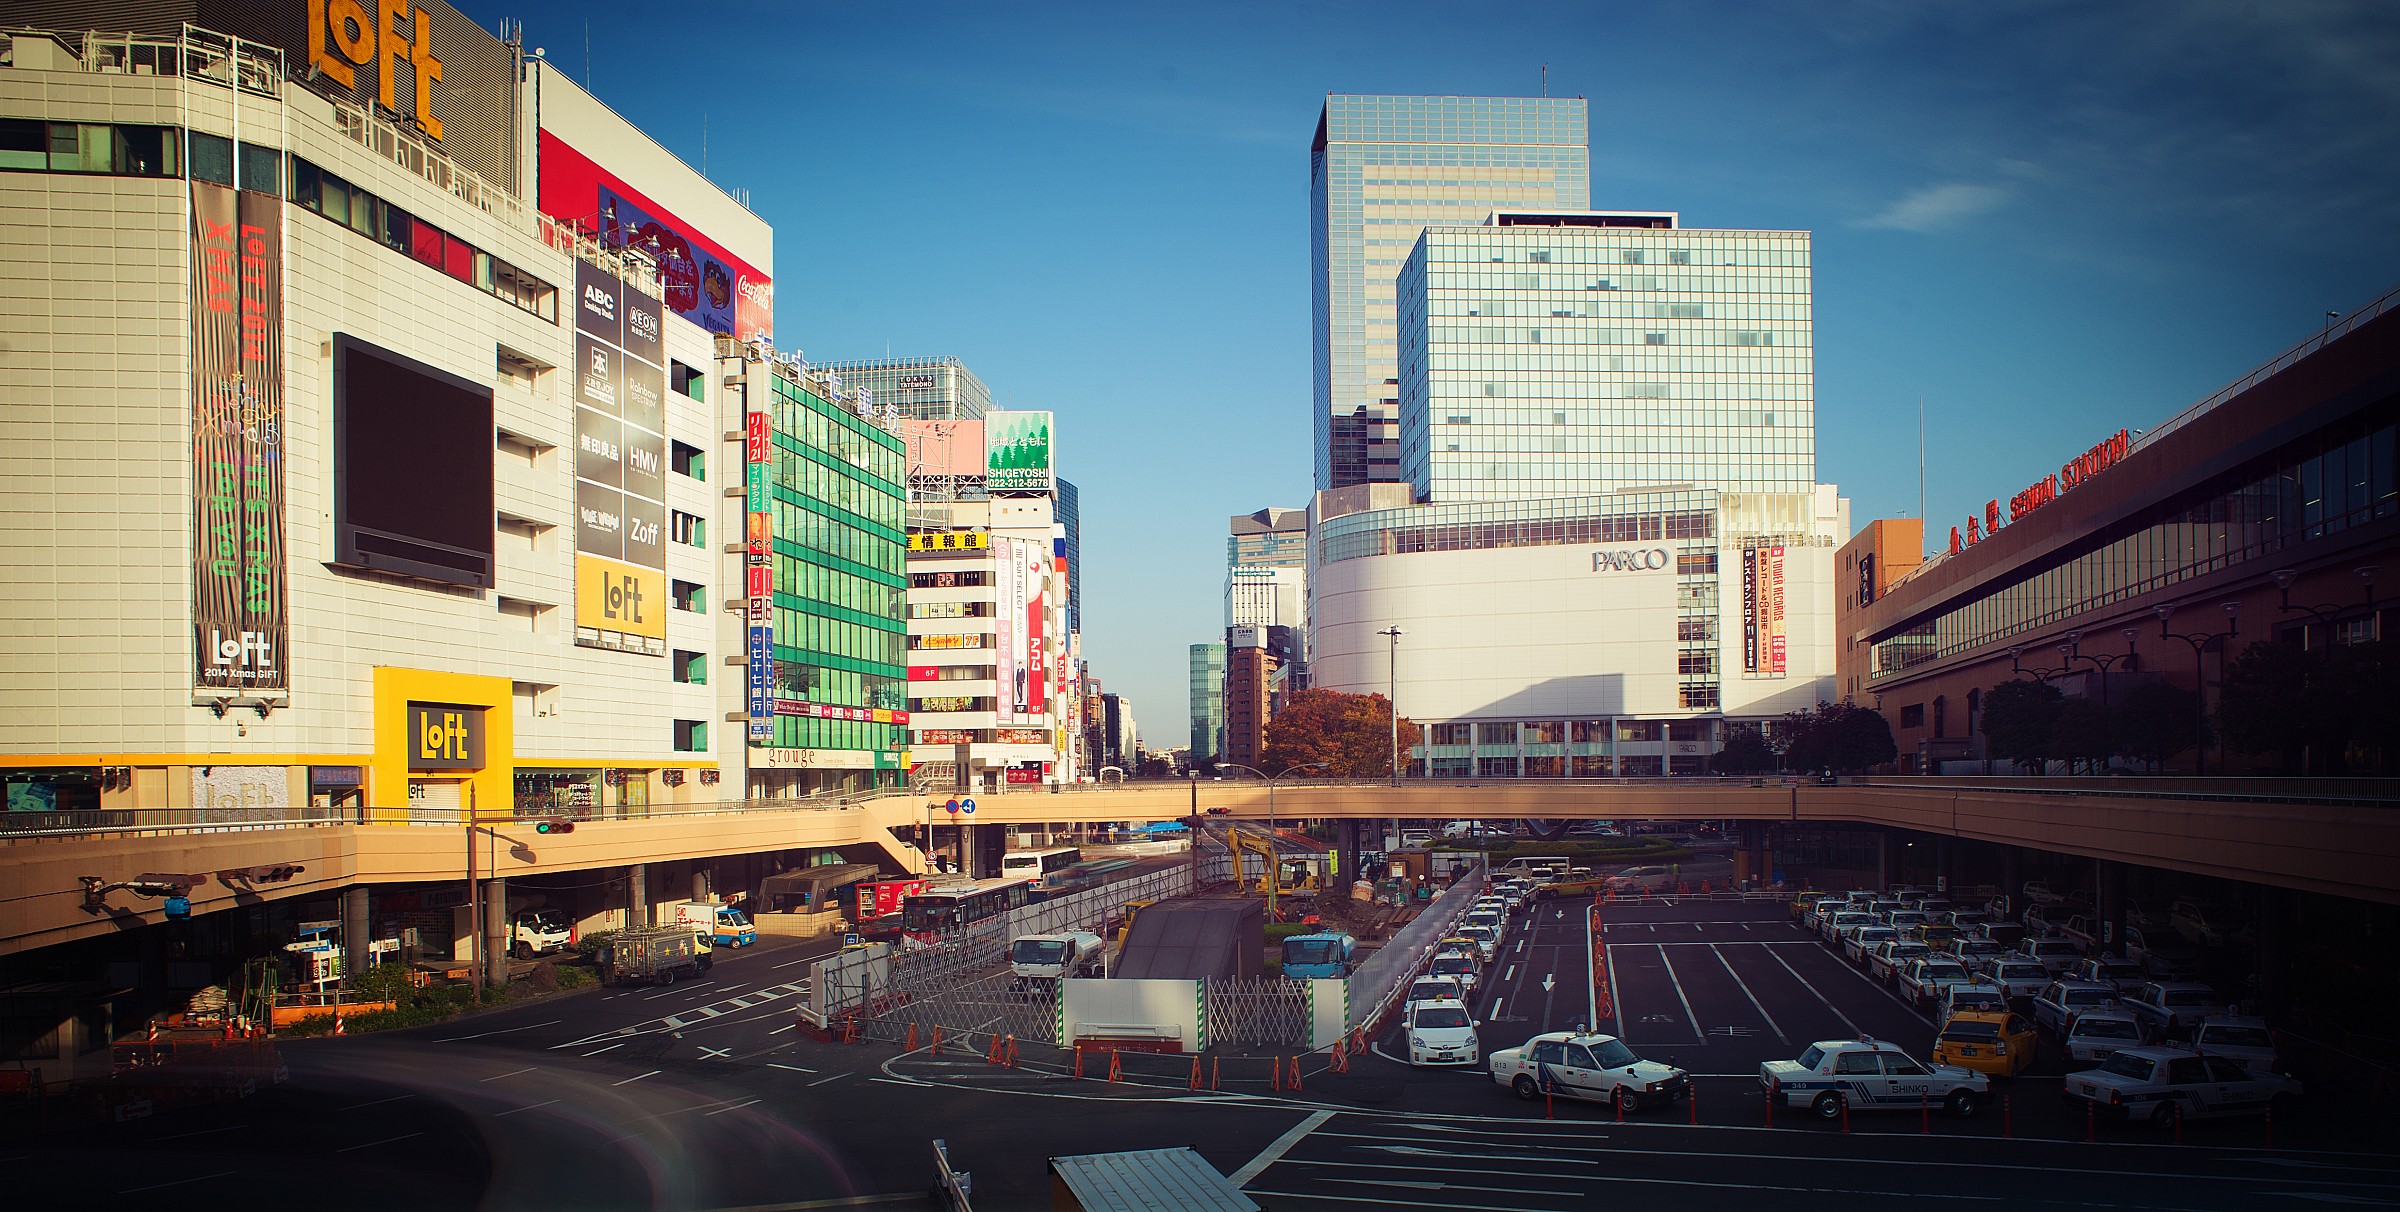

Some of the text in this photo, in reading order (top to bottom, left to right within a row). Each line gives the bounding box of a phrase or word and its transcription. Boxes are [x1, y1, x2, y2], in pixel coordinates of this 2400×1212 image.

[206, 218, 232, 313] XMAS
[584, 283, 614, 310] ABC
[242, 297, 267, 362] 2014
[630, 306, 658, 336] AEON
[629, 377, 658, 400] Rainbow
[580, 433, 619, 462] 無印良品
[751, 414, 761, 461] リーブ21
[630, 446, 658, 473] HMV
[988, 468, 1049, 478] SHIGEYOSHI
[989, 479, 1049, 488] 022-212-5678
[2010, 428, 2128, 522] SENDAI STATION
[631, 517, 659, 546] Zoff
[245, 523, 270, 613] XMAS
[1591, 548, 1670, 572] PARCO
[1773, 559, 1784, 622] TOWER RECORDS
[1030, 638, 1041, 671] アコム
[204, 668, 278, 679] 2014 Xmas GIFT
[751, 648, 763, 712] 七十七銀行
[925, 669, 935, 677] 6F
[1057, 659, 1066, 678] アコム
[1032, 705, 1040, 713] 6F
[768, 748, 815, 768] grouge
[1679, 744, 1697, 753] PARCO
[1892, 1085, 1929, 1094] SHINKO
[2222, 1091, 2254, 1102] SHINKO
